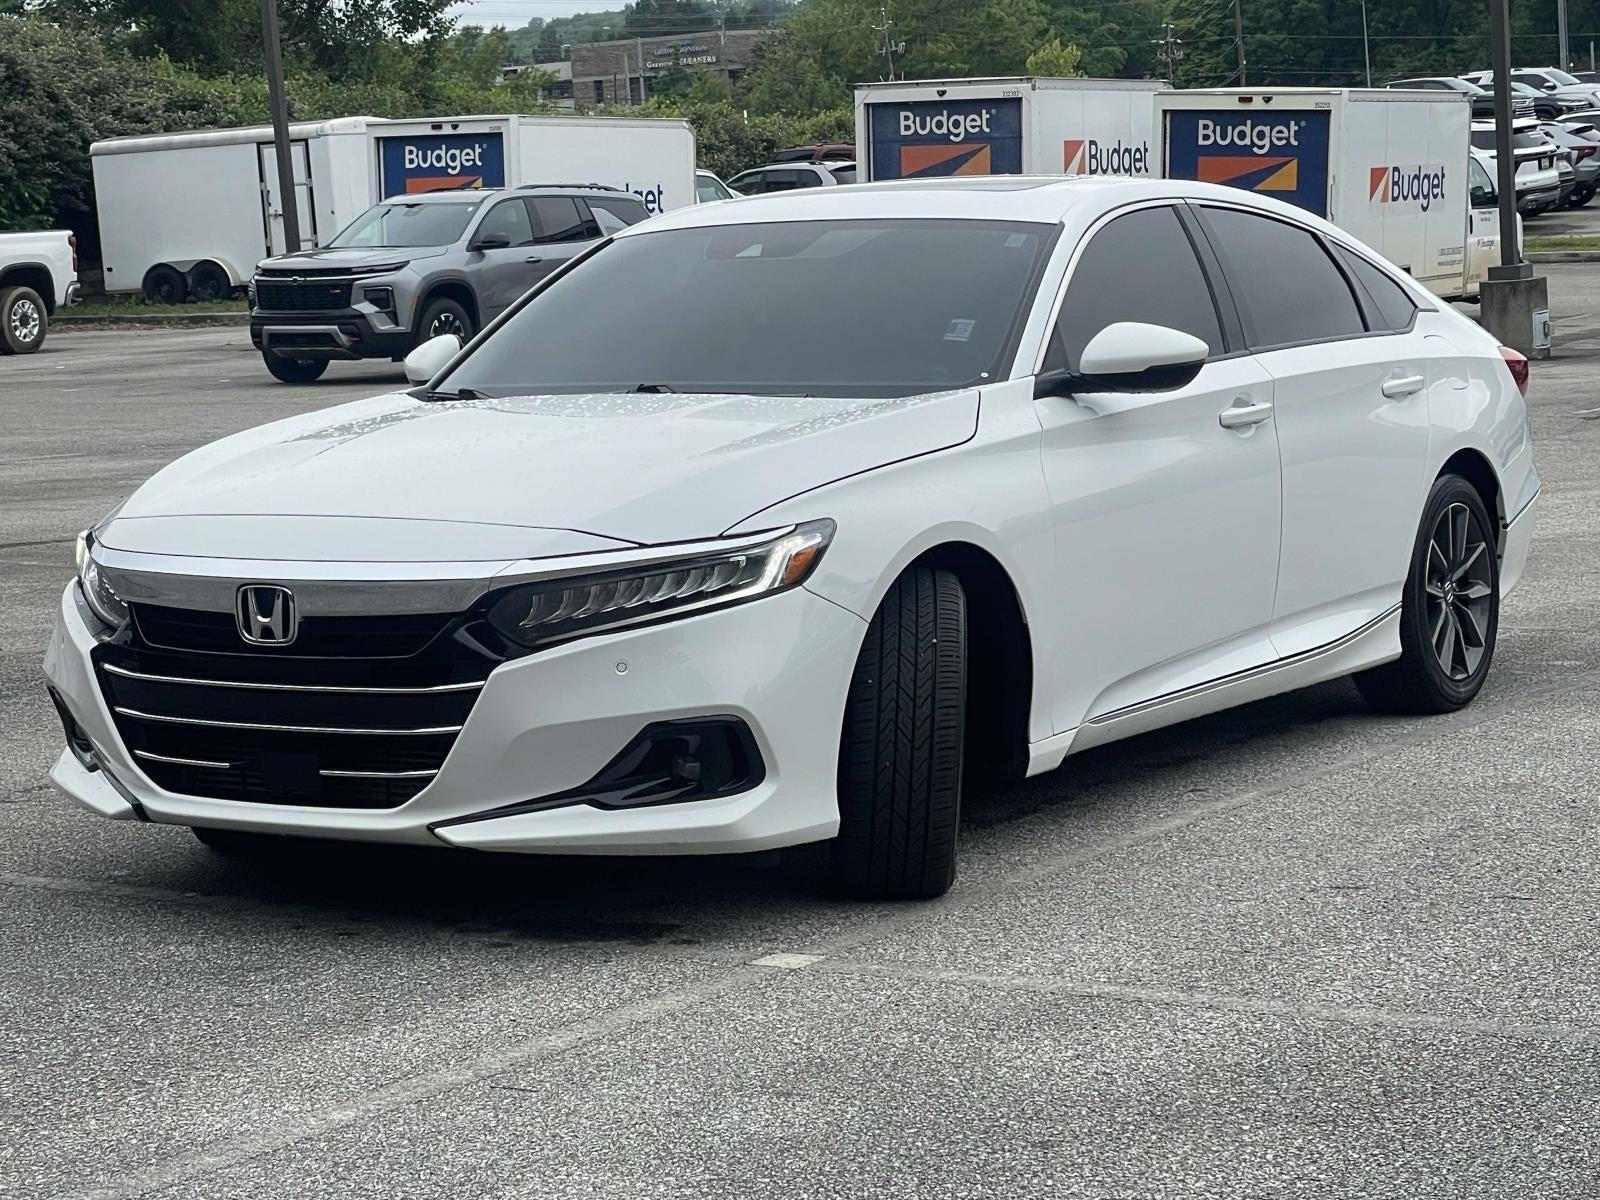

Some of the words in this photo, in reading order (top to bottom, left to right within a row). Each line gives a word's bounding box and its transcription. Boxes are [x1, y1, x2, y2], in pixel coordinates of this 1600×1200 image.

[899, 109, 991, 146] Budget
[1197, 119, 1299, 155] Budget
[404, 143, 482, 175] Budget
[1391, 165, 1446, 213] Budget
